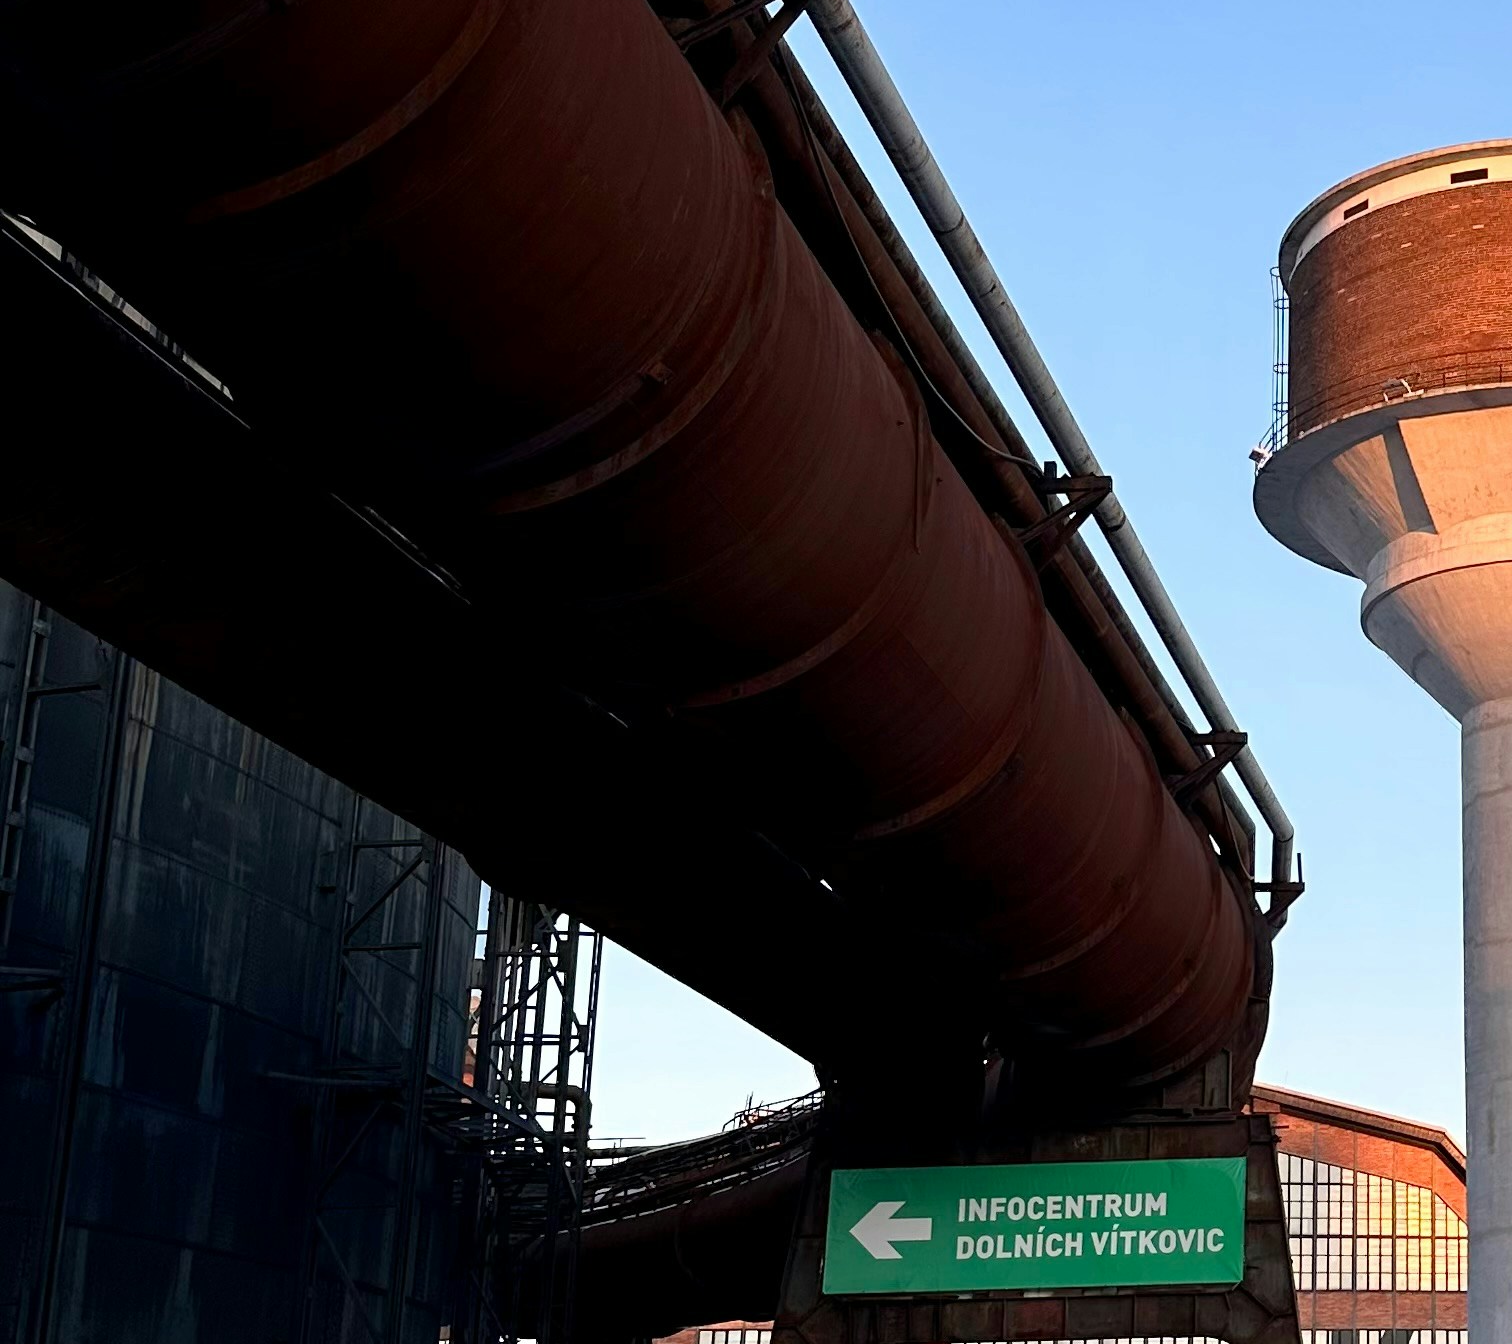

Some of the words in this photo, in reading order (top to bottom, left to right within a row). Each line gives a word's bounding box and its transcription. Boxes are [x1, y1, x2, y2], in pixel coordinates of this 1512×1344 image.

[958, 1192, 1167, 1223] INFOCENTRUM
[956, 1225, 1083, 1260] DOLNÍCH
[1091, 1223, 1225, 1256] VÍTKOVIC
